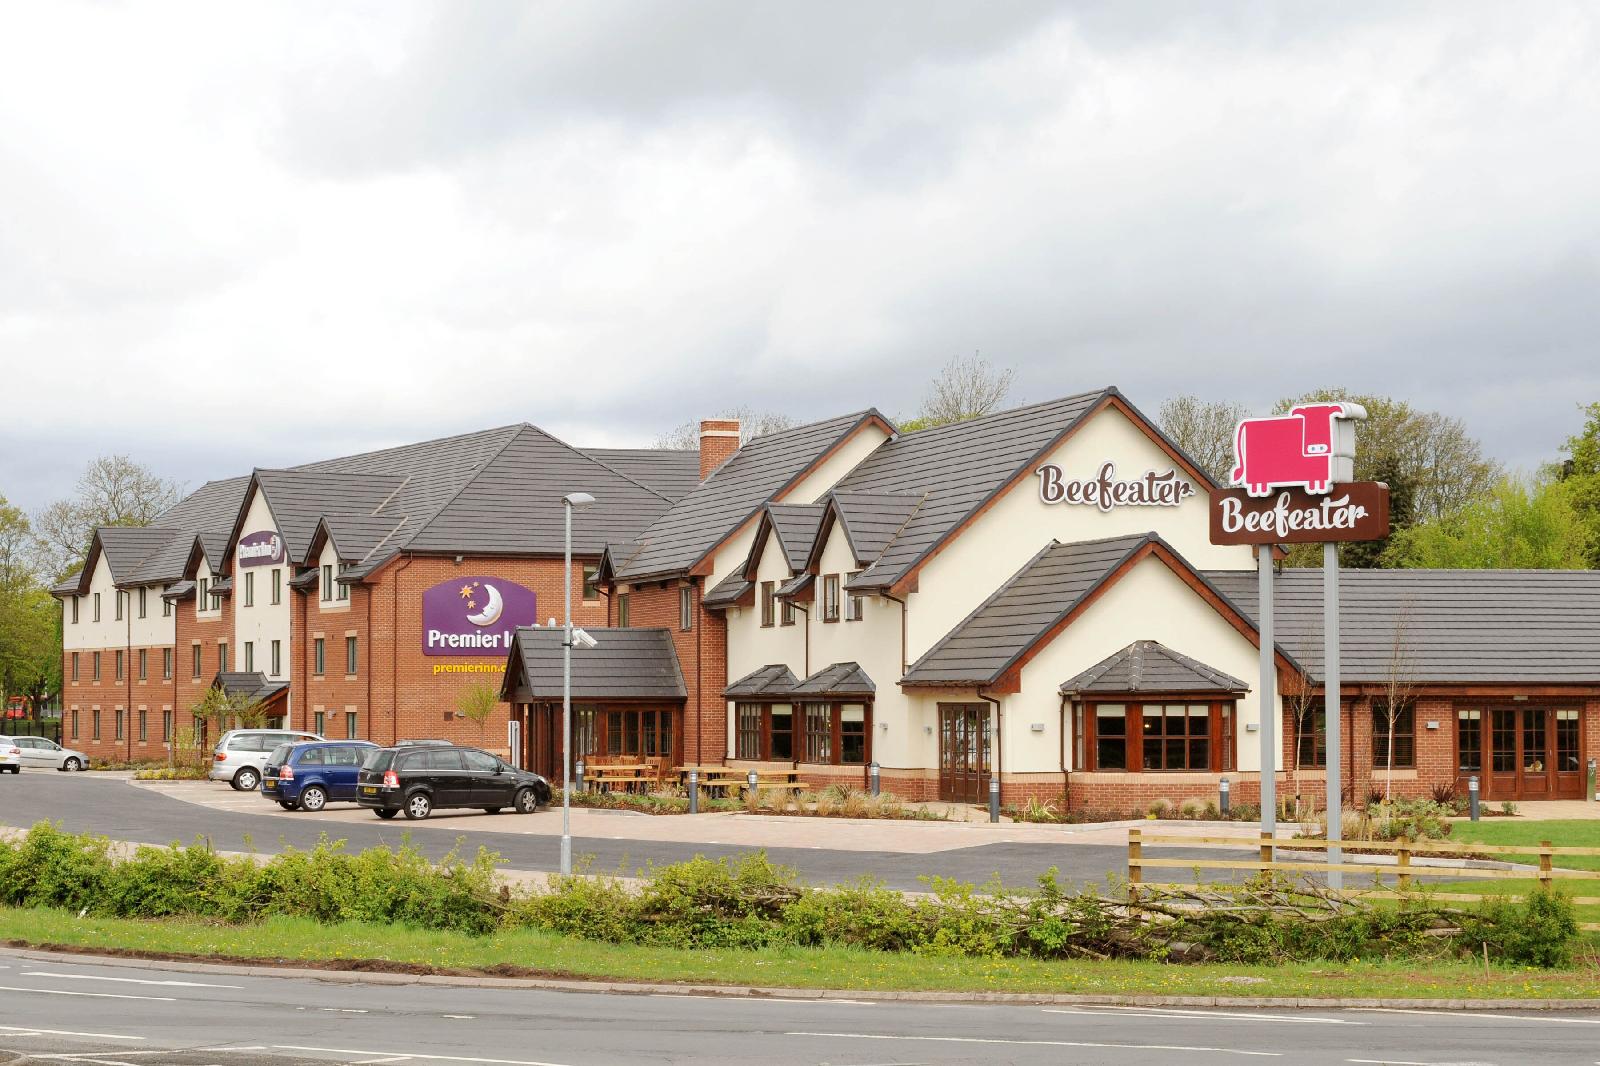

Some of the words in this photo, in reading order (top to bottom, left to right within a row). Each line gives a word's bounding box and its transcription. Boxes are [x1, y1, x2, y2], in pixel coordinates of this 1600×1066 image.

[1037, 461, 1195, 510] Beefeater
[1218, 491, 1369, 538] Beefeater
[428, 629, 502, 648] Premier
